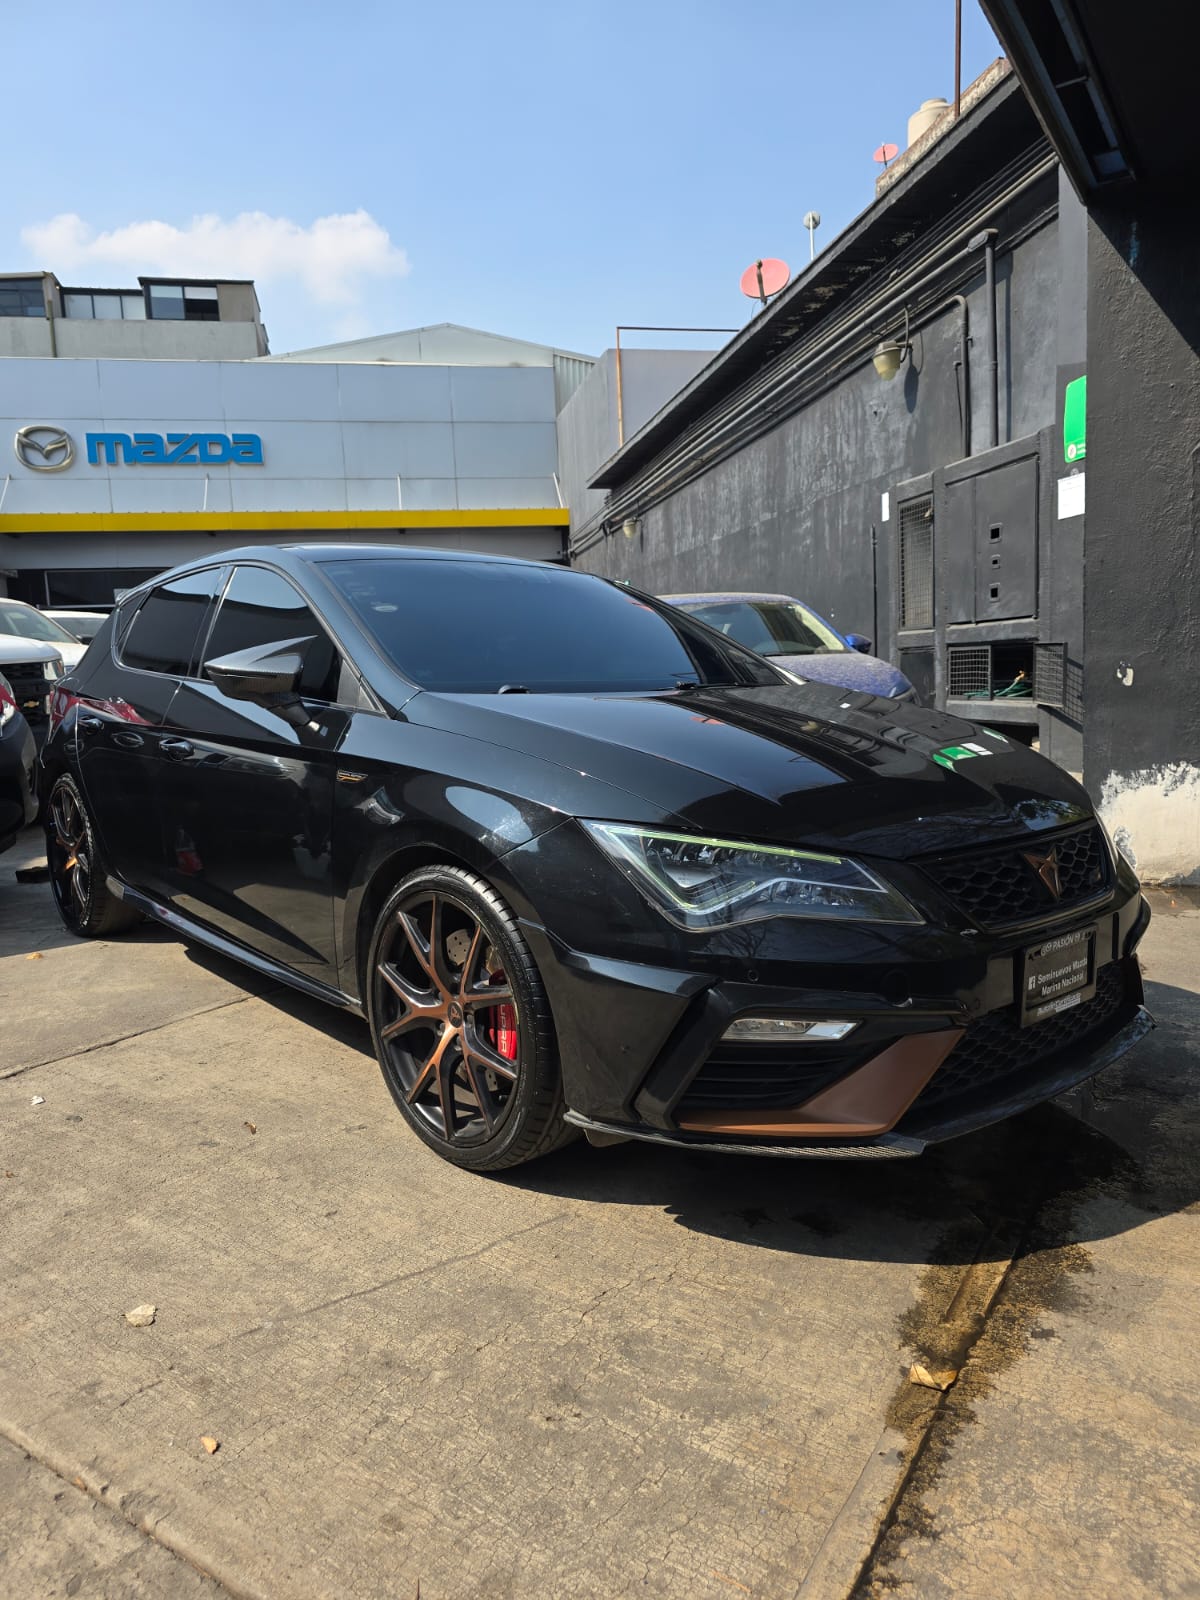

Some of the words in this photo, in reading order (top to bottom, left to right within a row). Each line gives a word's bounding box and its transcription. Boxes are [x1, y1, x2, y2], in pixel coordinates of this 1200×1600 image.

[86, 432, 264, 465] mazda
[1037, 965, 1072, 984] Seminuevos
[1041, 981, 1061, 996] Marina
[1061, 972, 1084, 987] Nacional
[500, 1004, 508, 1053] UPRA
